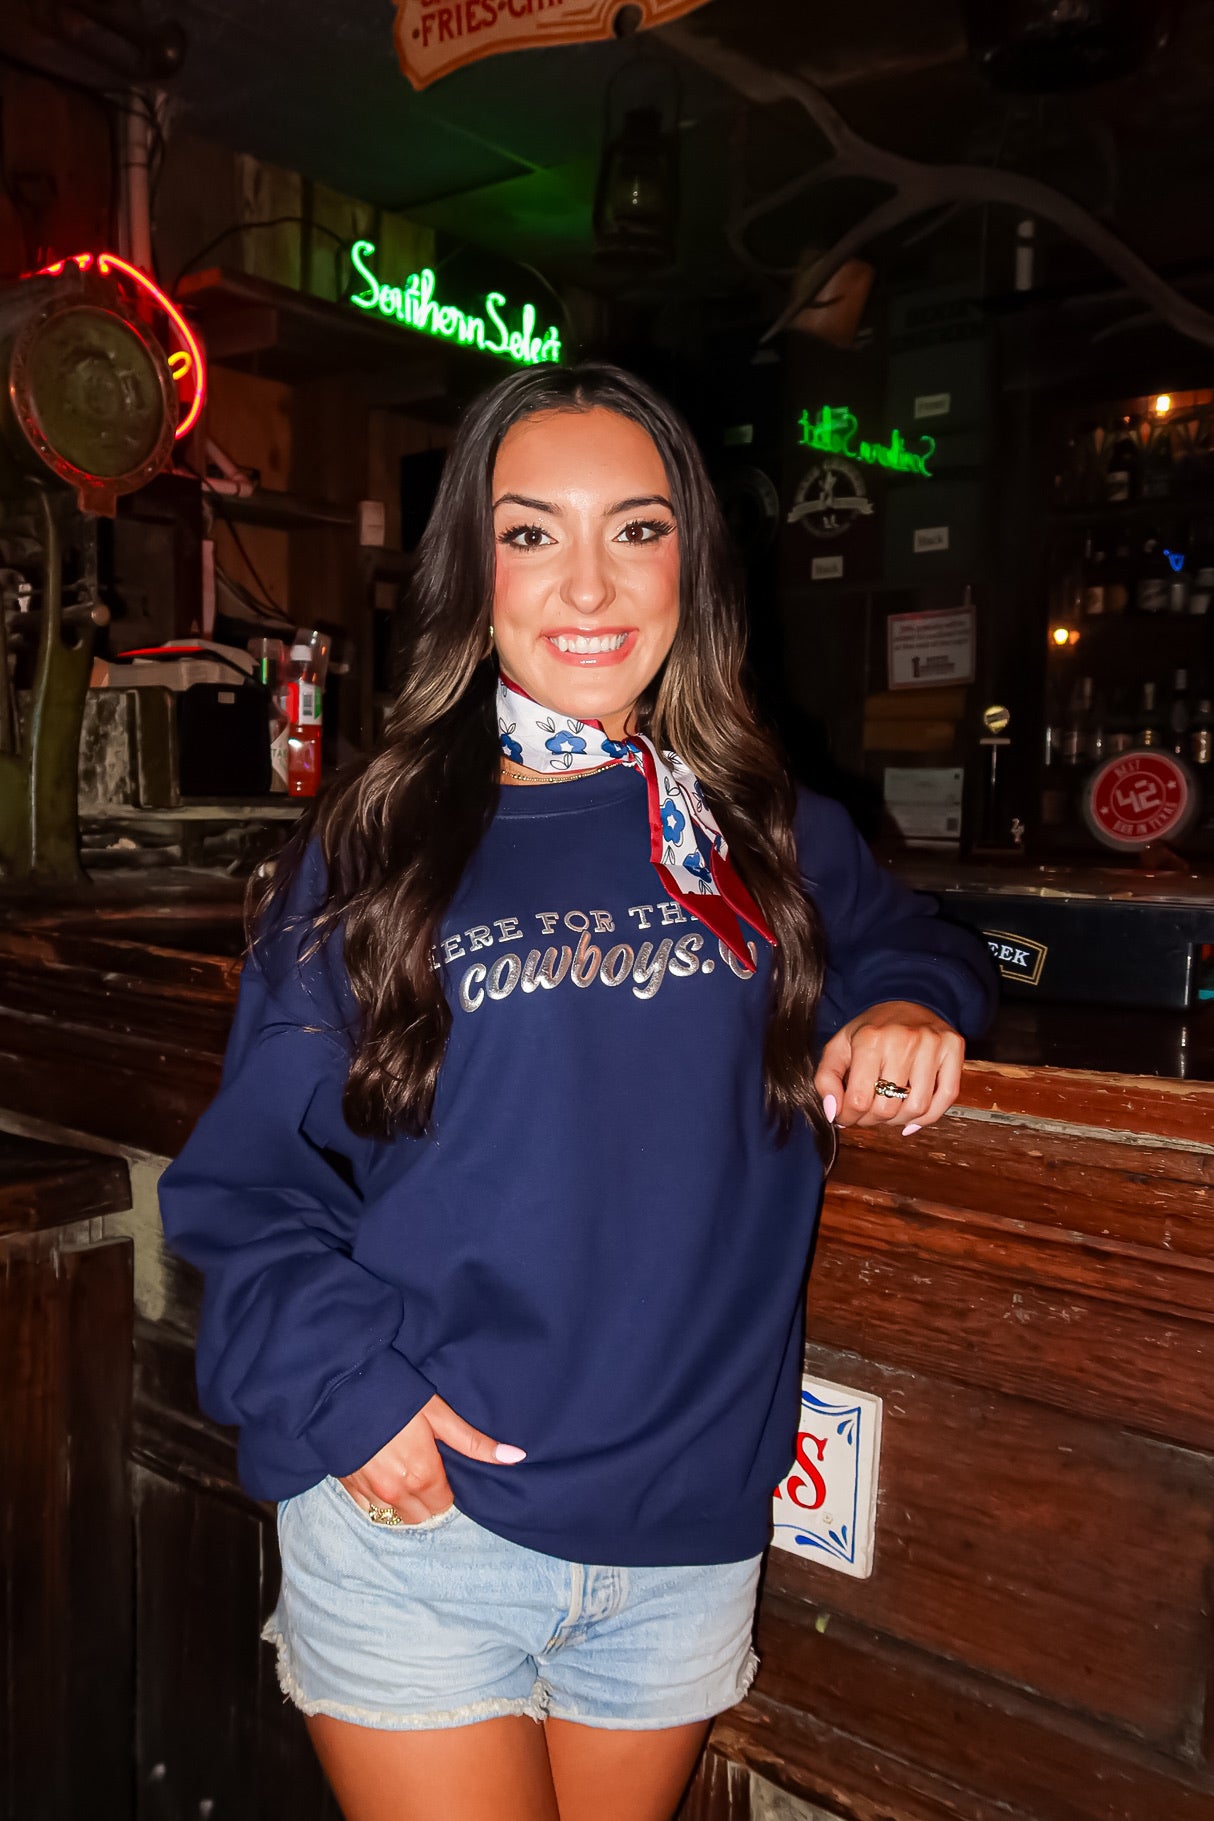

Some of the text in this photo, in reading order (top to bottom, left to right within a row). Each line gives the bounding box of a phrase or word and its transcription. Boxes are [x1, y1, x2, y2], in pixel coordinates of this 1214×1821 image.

[421, 0, 498, 47] FRIES
[351, 240, 562, 365] Southern Select
[1115, 780, 1161, 813] 42
[535, 910, 616, 936] FOR
[628, 901, 699, 930] TH
[773, 1432, 828, 1510] S
